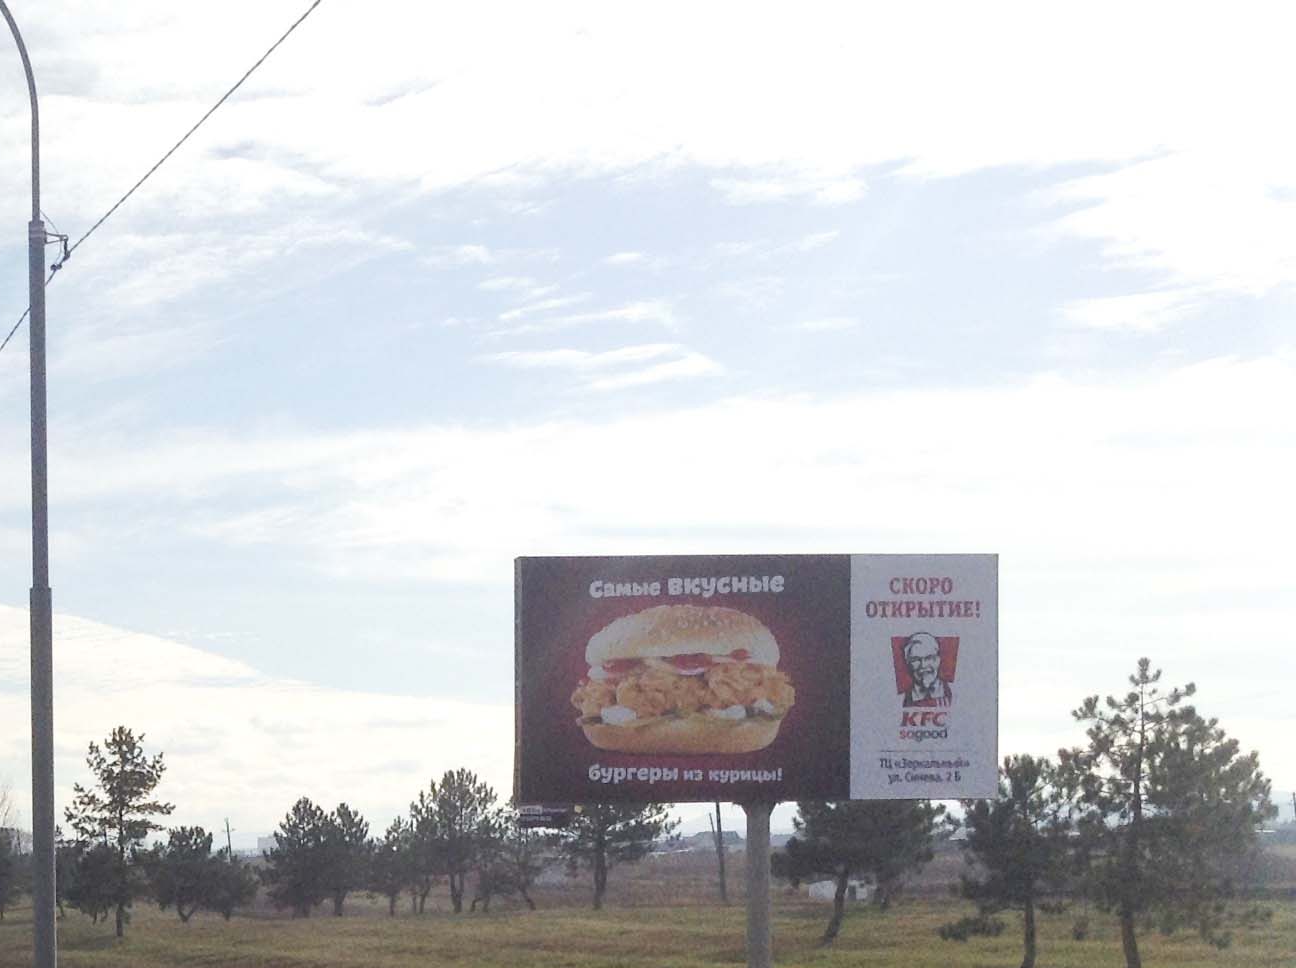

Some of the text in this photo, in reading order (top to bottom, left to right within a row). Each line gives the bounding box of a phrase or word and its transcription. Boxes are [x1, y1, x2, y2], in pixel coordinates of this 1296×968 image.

[589, 579, 661, 598] Самые
[889, 577, 953, 594] СКОРО
[865, 600, 980, 618] ОТКРЫТИЕ!
[900, 711, 948, 727] KFC
[588, 764, 783, 784] бургеры из курицы!
